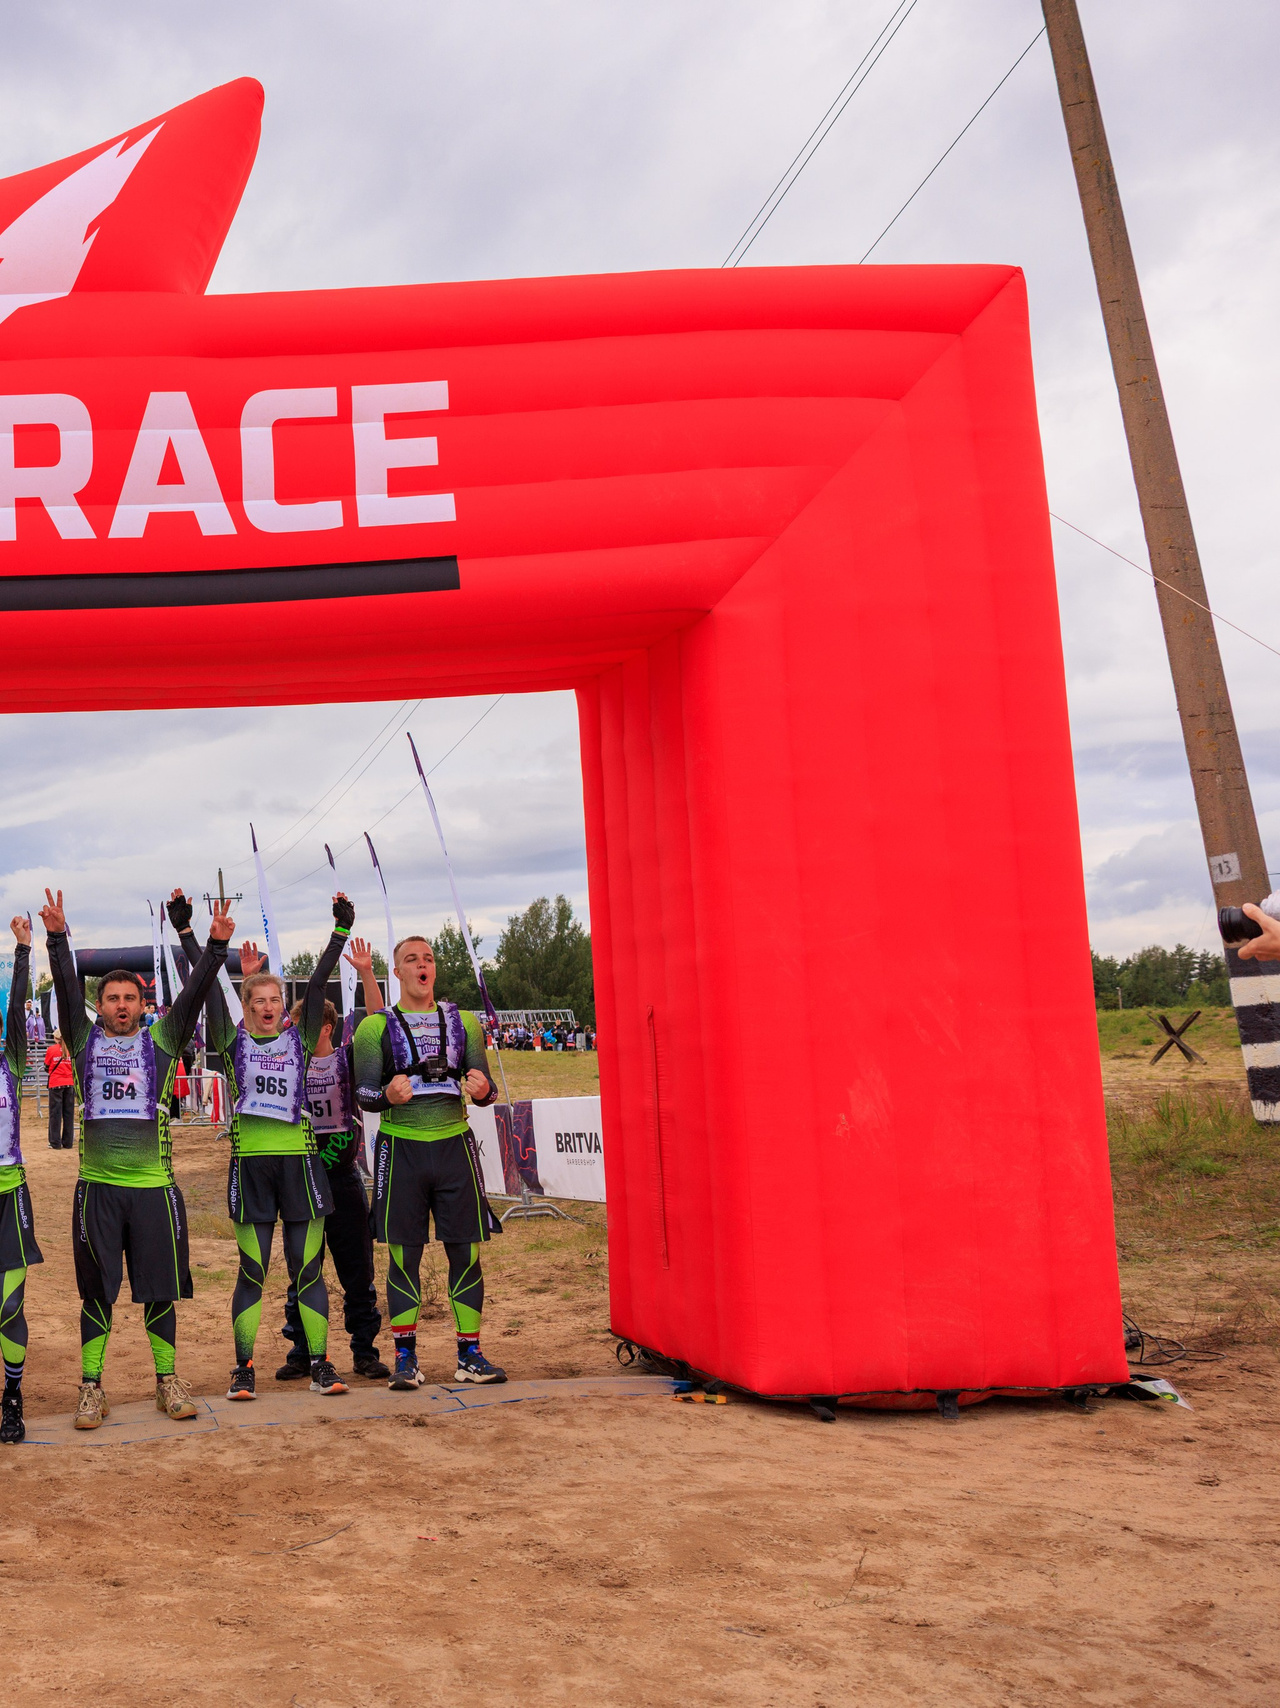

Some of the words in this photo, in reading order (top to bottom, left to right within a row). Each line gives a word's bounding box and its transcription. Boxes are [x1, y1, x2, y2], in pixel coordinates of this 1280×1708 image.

[1218, 860, 1232, 875] 13
[107, 1067, 129, 1076] СТАРТ
[261, 1062, 284, 1071] СТАРТ
[102, 1081, 138, 1101] 964
[255, 1075, 288, 1098] 965
[555, 1132, 602, 1154] BRITVA
